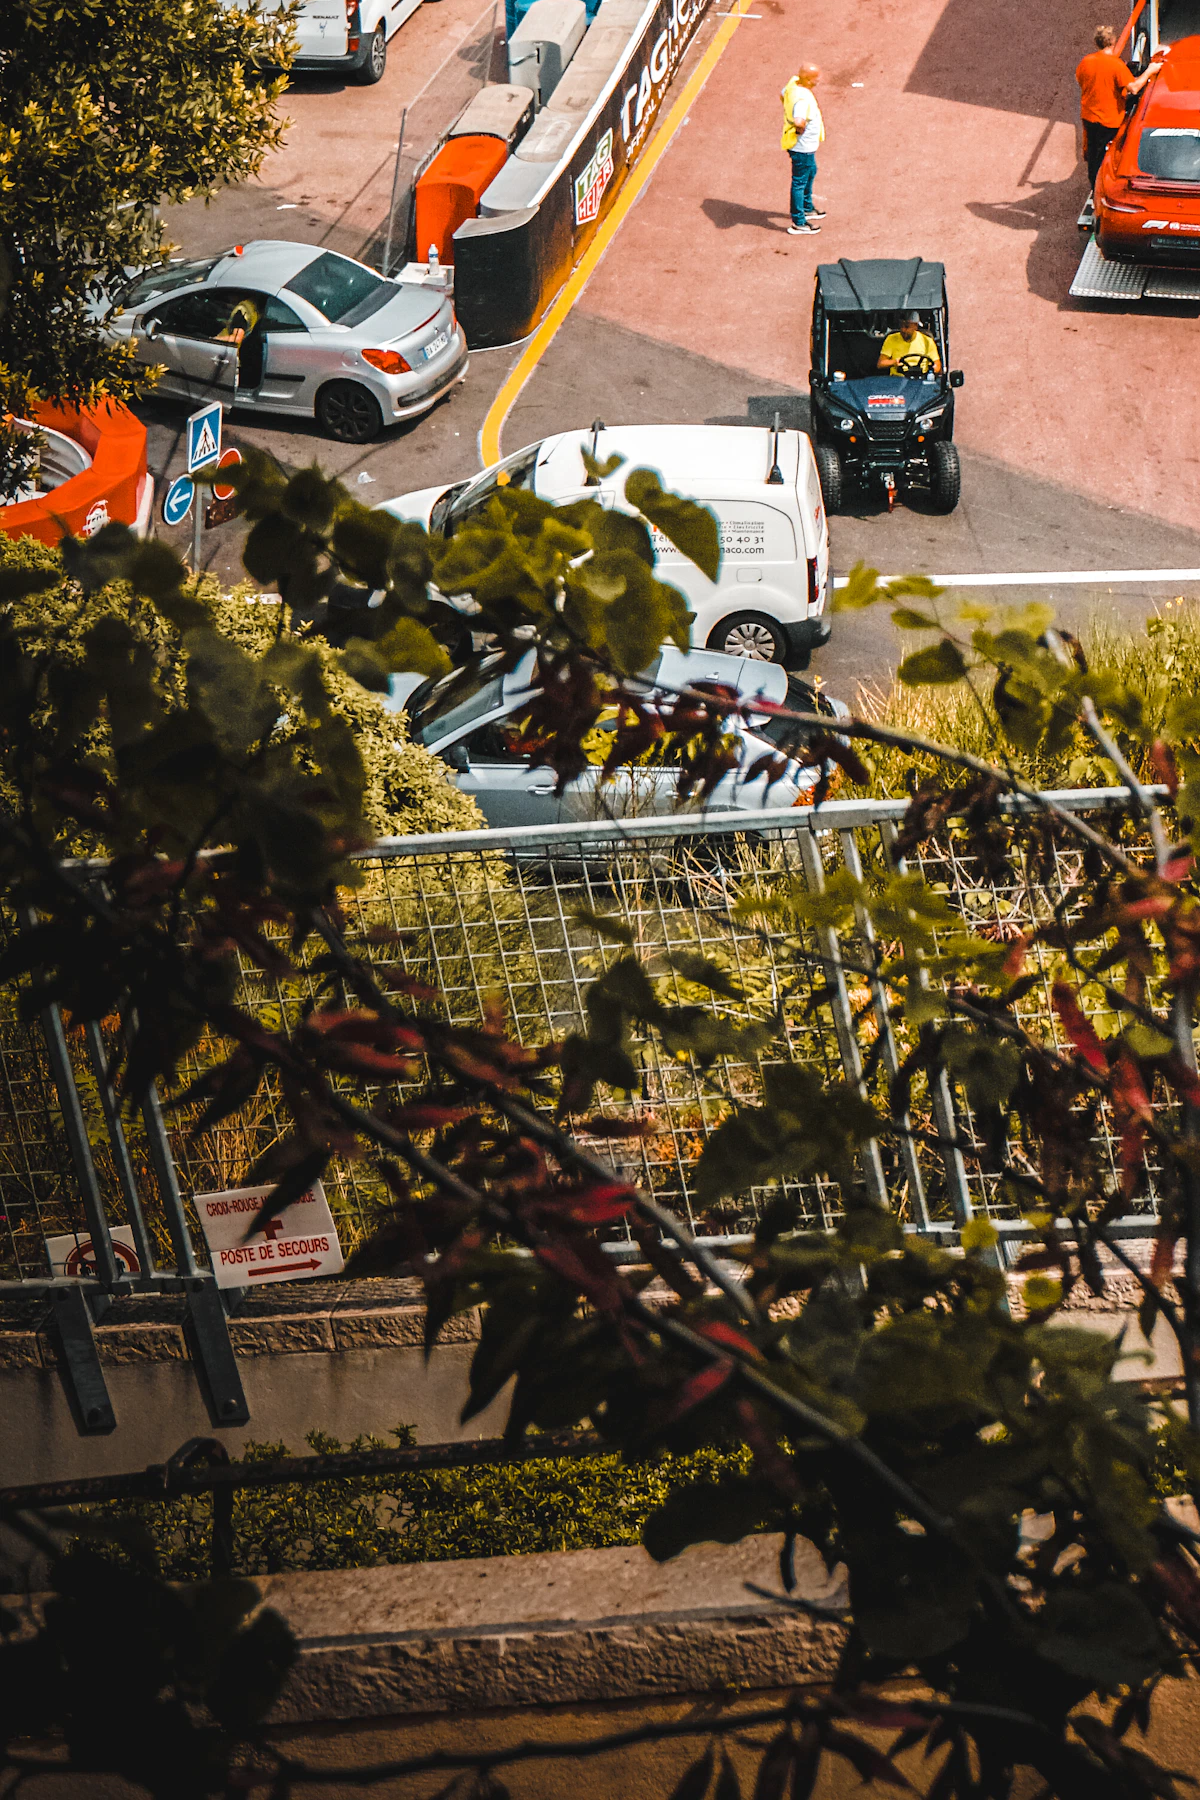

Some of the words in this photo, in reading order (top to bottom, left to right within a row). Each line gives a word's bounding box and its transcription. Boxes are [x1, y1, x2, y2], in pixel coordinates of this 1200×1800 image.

[736, 536, 750, 544] 40
[754, 536, 764, 544] 31
[206, 1197, 260, 1216] CROIX-ROUGE
[220, 1247, 256, 1266] POSTE
[258, 1244, 274, 1260] DE
[278, 1237, 330, 1258] SECOURS
